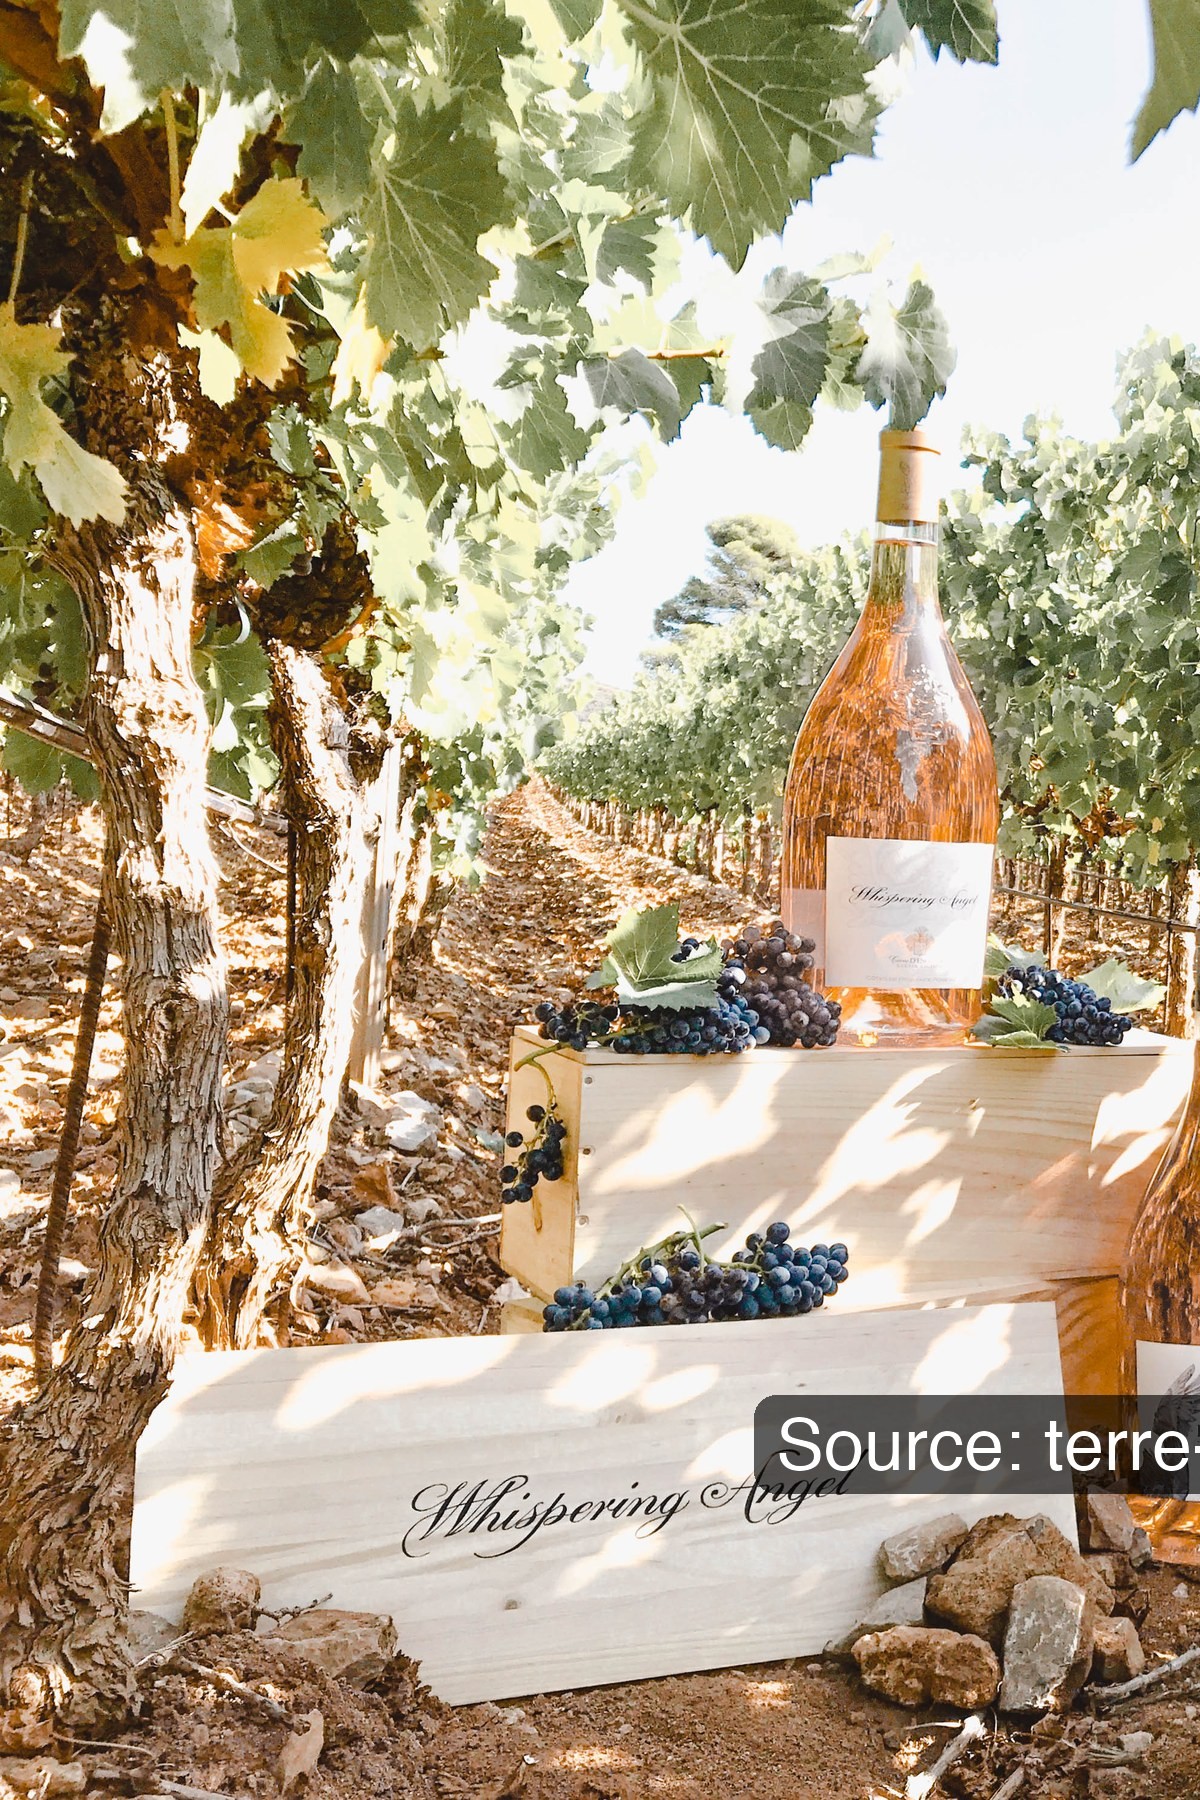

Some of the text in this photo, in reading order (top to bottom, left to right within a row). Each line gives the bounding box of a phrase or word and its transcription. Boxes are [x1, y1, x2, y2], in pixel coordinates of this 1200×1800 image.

[848, 885, 978, 910] Whispering Angel
[401, 1448, 868, 1558] Whispering Angel
